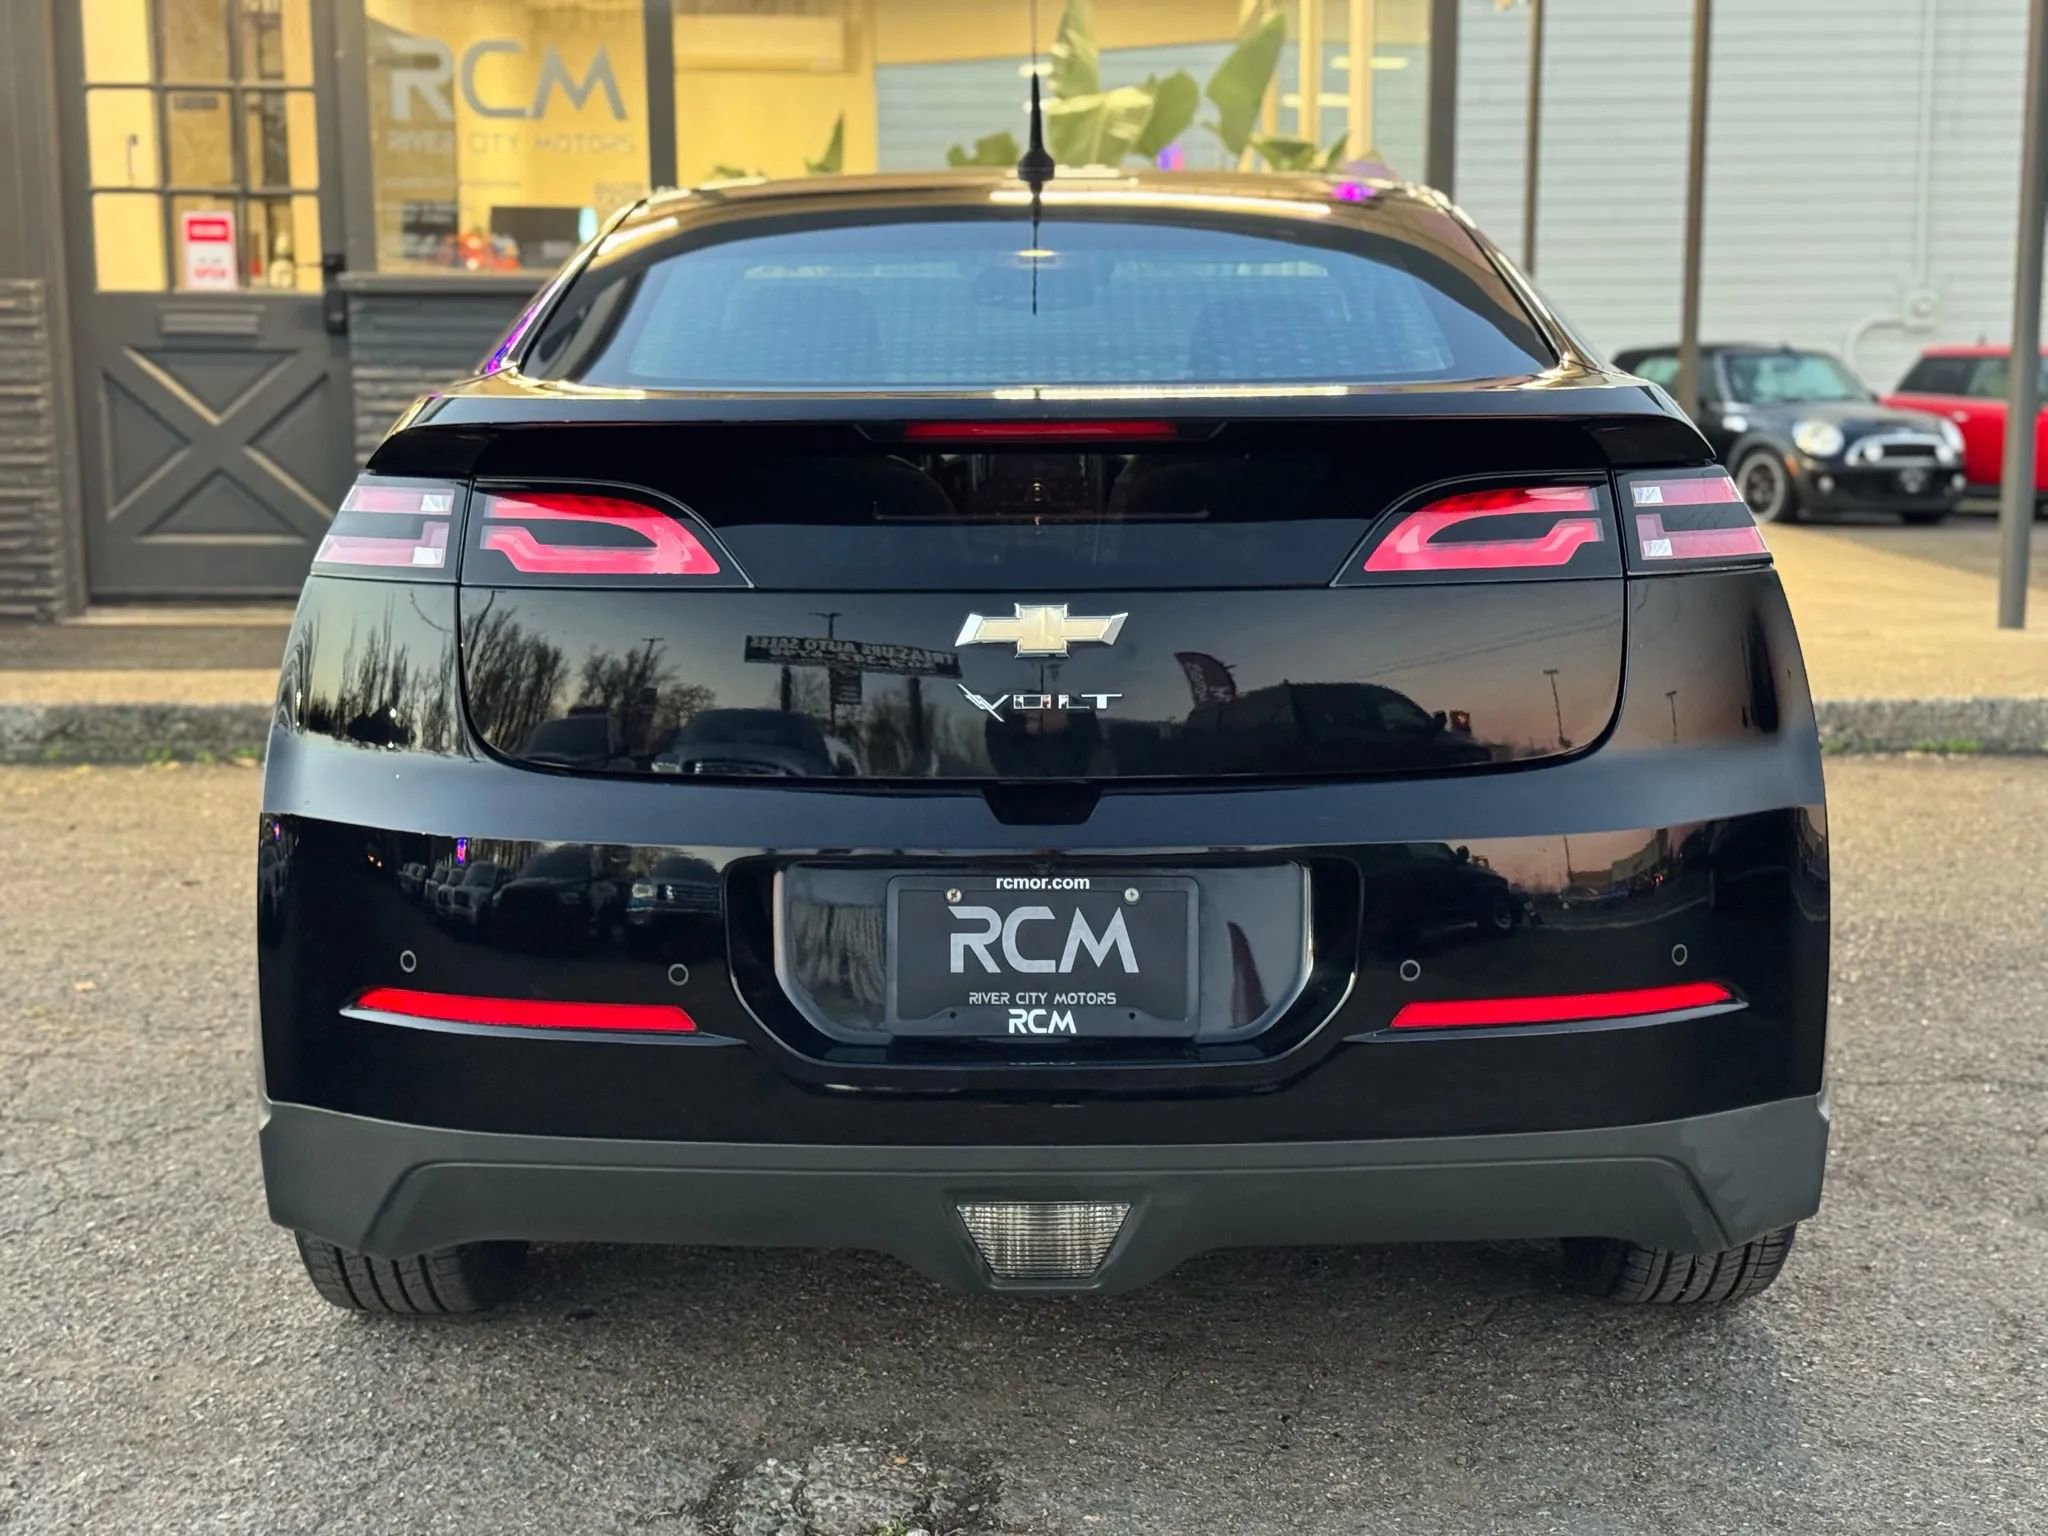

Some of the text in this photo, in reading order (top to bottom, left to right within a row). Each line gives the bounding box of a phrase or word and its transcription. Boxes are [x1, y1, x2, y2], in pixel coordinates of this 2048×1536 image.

[386, 36, 628, 121] RCM
[957, 683, 1123, 723] VOLT
[995, 876, 1091, 890] rcmor.com
[948, 906, 1140, 973] RCM
[968, 992, 1117, 1005] RIVER CITY MOTORS
[1008, 1008, 1077, 1034] RCM
